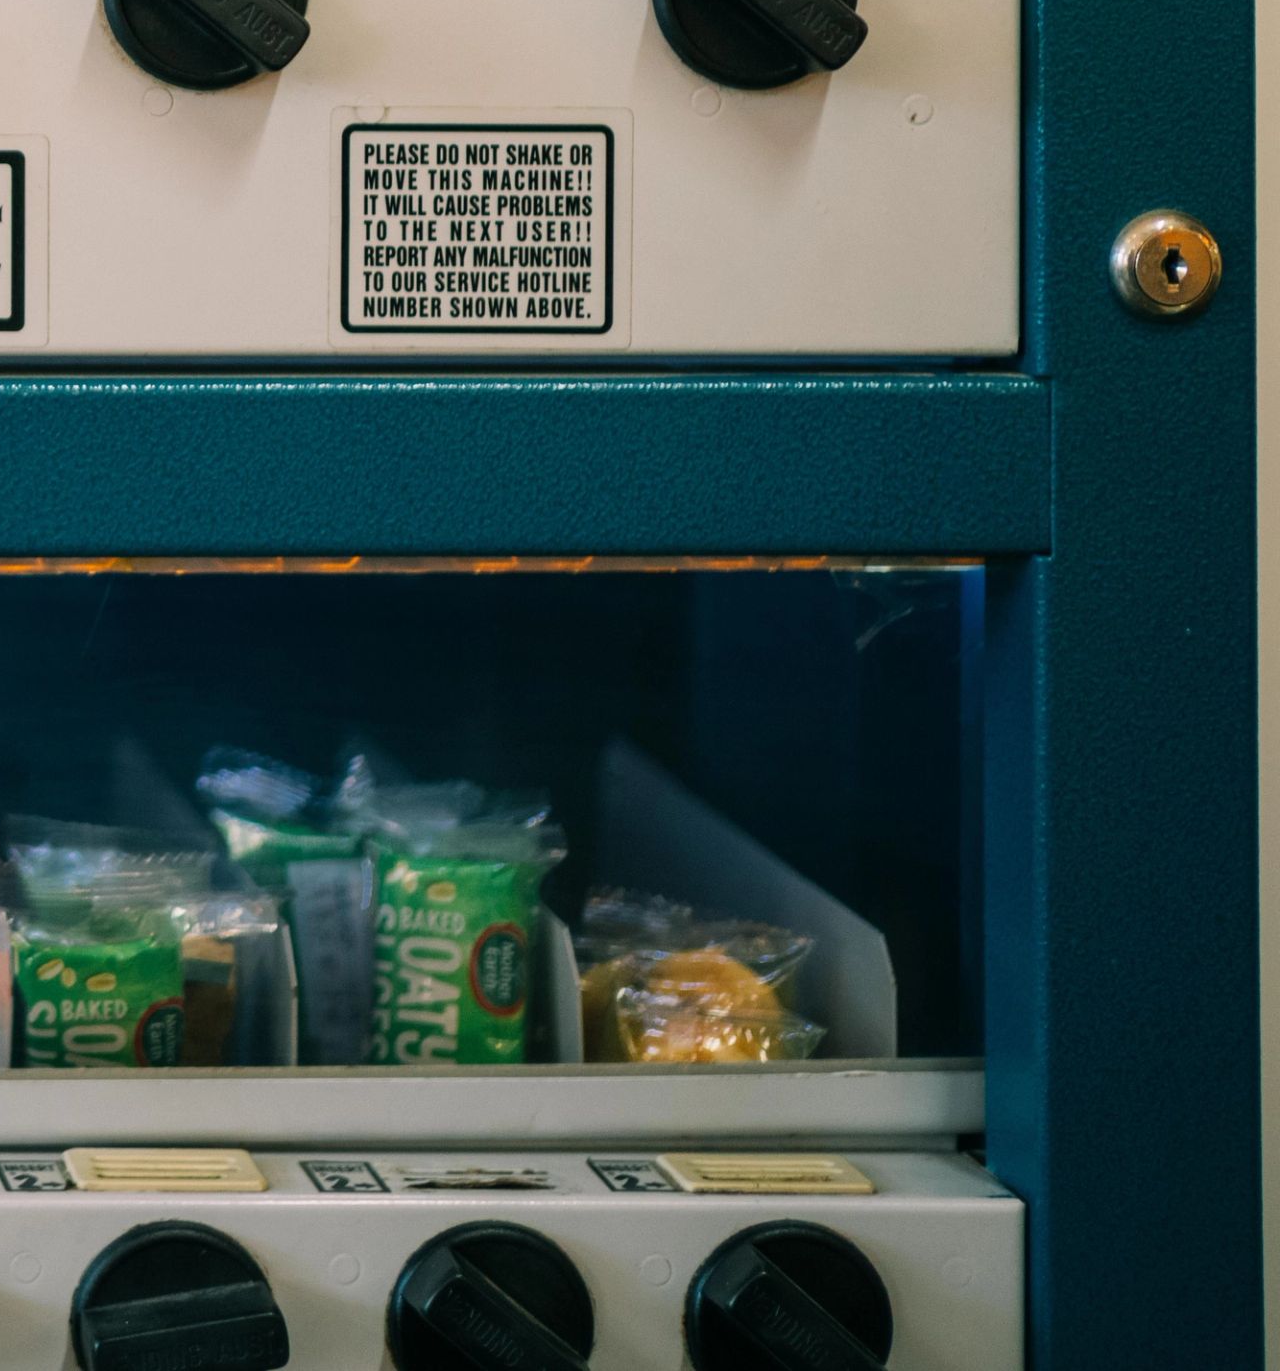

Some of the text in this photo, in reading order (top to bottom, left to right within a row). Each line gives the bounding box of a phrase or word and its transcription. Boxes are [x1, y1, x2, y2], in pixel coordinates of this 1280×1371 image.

[364, 143, 593, 166] PLEASE DO NOT SHAKE OR
[364, 168, 592, 192] MOVE THIS MACHINE!!
[363, 194, 593, 217] IT WILL CAUSE PROBLEMS
[363, 219, 591, 243] TO THE NEXT USER!!
[363, 245, 592, 268] REPORT ANY MALFUNCTION
[363, 271, 592, 294] TO OUR SERVICE HOTLINE
[363, 296, 591, 319] NUMBER SHOWN ABOVE.
[60, 999, 128, 1021] BAKED
